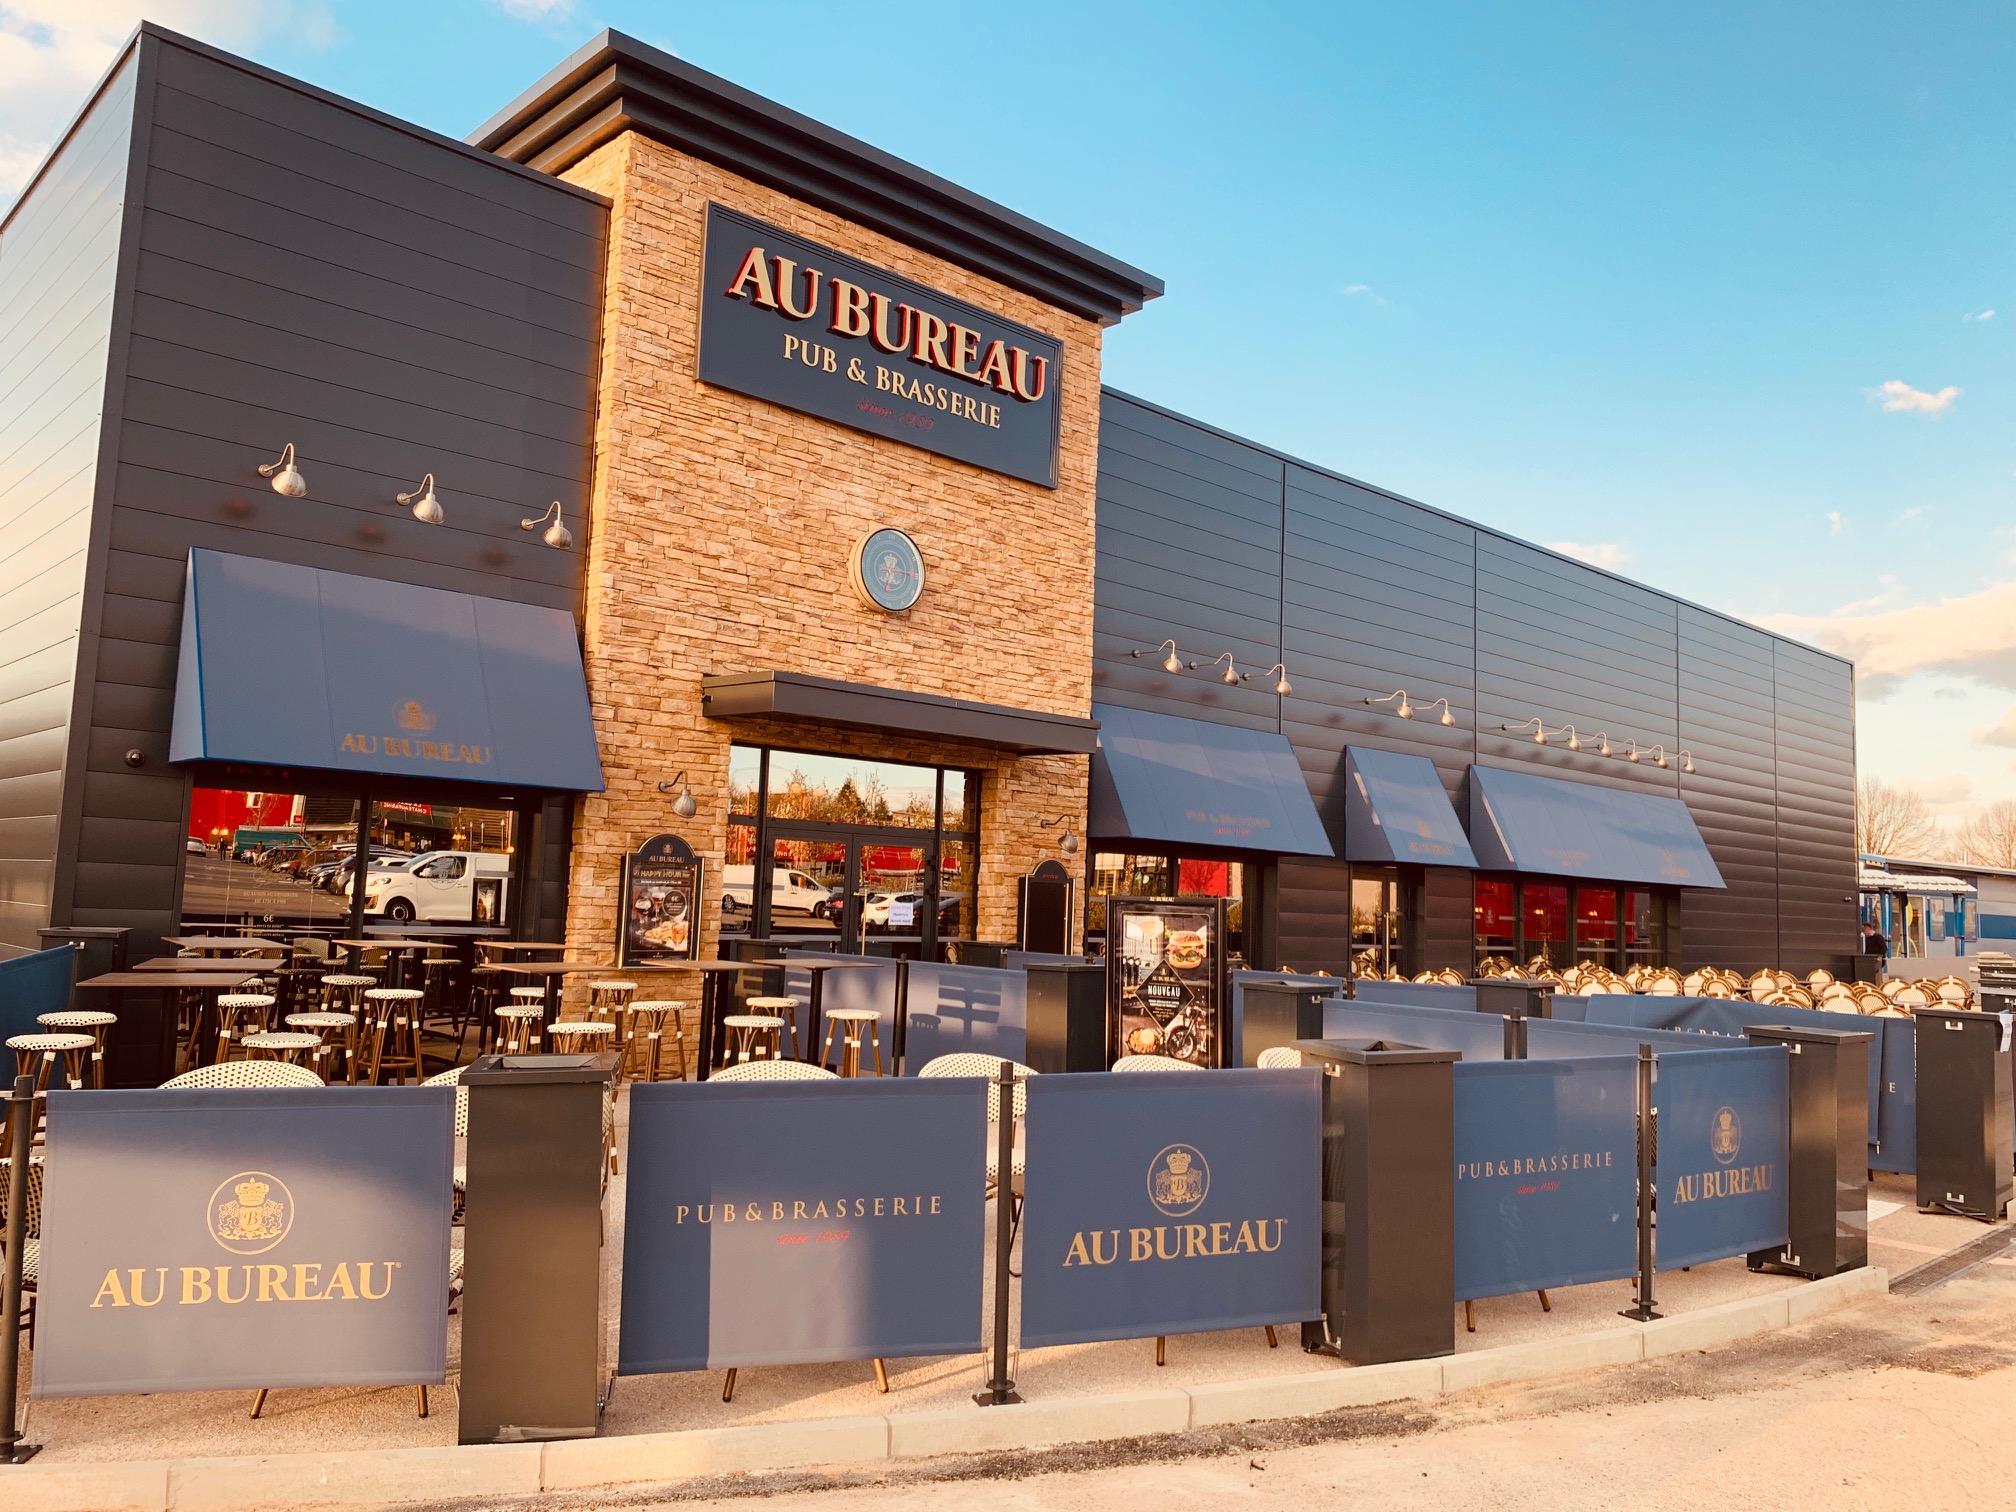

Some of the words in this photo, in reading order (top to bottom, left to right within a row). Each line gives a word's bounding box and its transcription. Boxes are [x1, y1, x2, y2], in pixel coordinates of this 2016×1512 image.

[727, 247, 823, 320] AU
[830, 277, 1049, 402] BUREAU
[783, 333, 837, 374] PUB
[846, 357, 869, 386] &
[875, 365, 1001, 429] BRASSERIE
[341, 733, 378, 755] AU
[383, 736, 491, 765] BUREAU
[263, 913, 275, 923] 6€
[1148, 985, 1180, 997] NOUVEAU
[1673, 1174, 1700, 1204] AU
[1703, 1164, 1775, 1199] BUREAU
[775, 1232, 810, 1246] since
[815, 1230, 852, 1244] 1989
[1062, 1230, 1121, 1267] AU
[89, 1267, 169, 1308] AU
